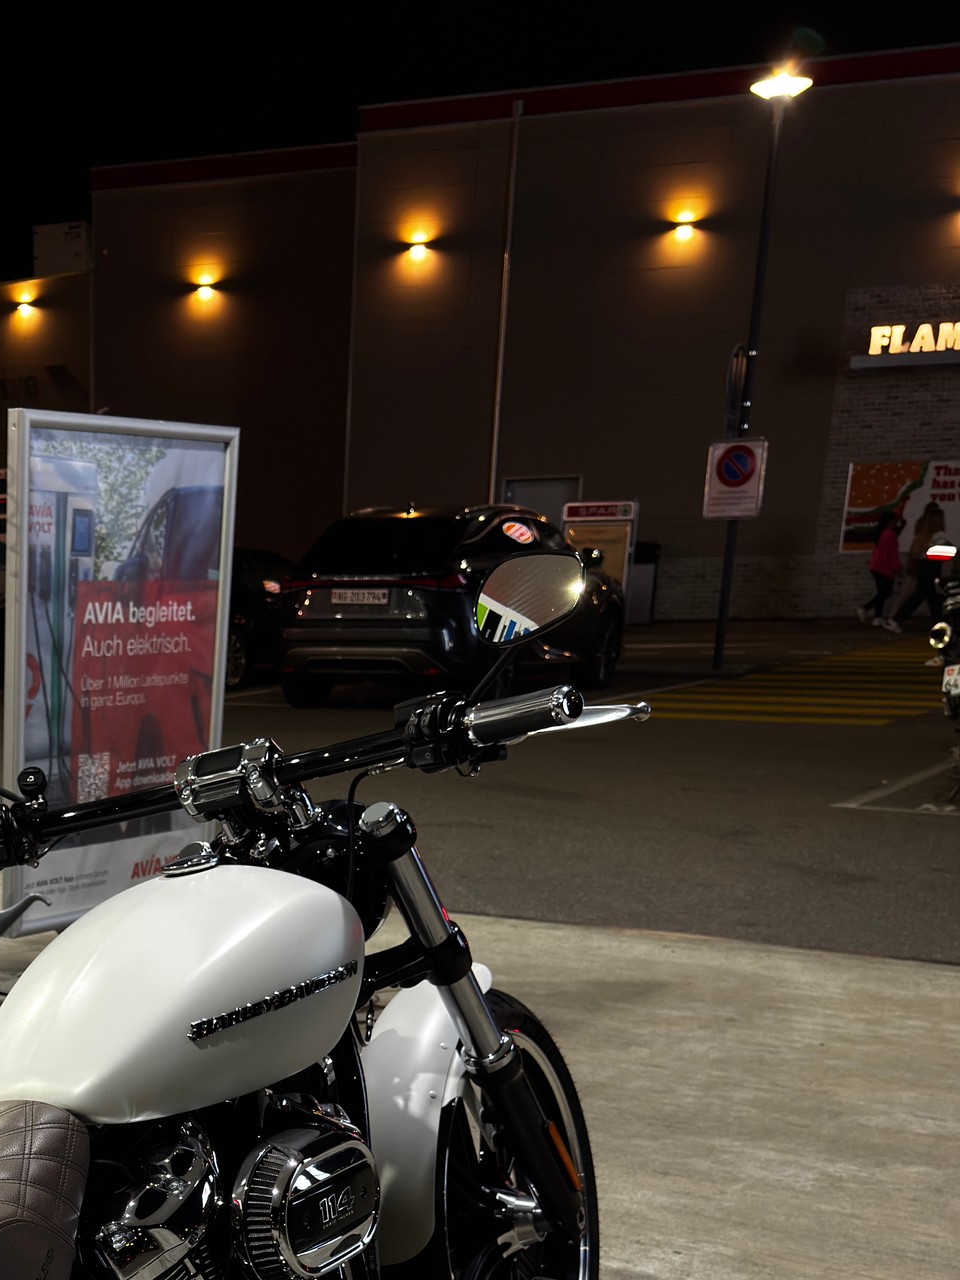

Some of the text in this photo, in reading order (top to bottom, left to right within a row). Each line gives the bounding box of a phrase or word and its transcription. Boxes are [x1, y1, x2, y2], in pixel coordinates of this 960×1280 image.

[83, 600, 196, 628] AVIA begleitet.
[81, 632, 192, 657] Auch elektrisch.
[81, 674, 104, 691] Über
[319, 1186, 355, 1223] 114
